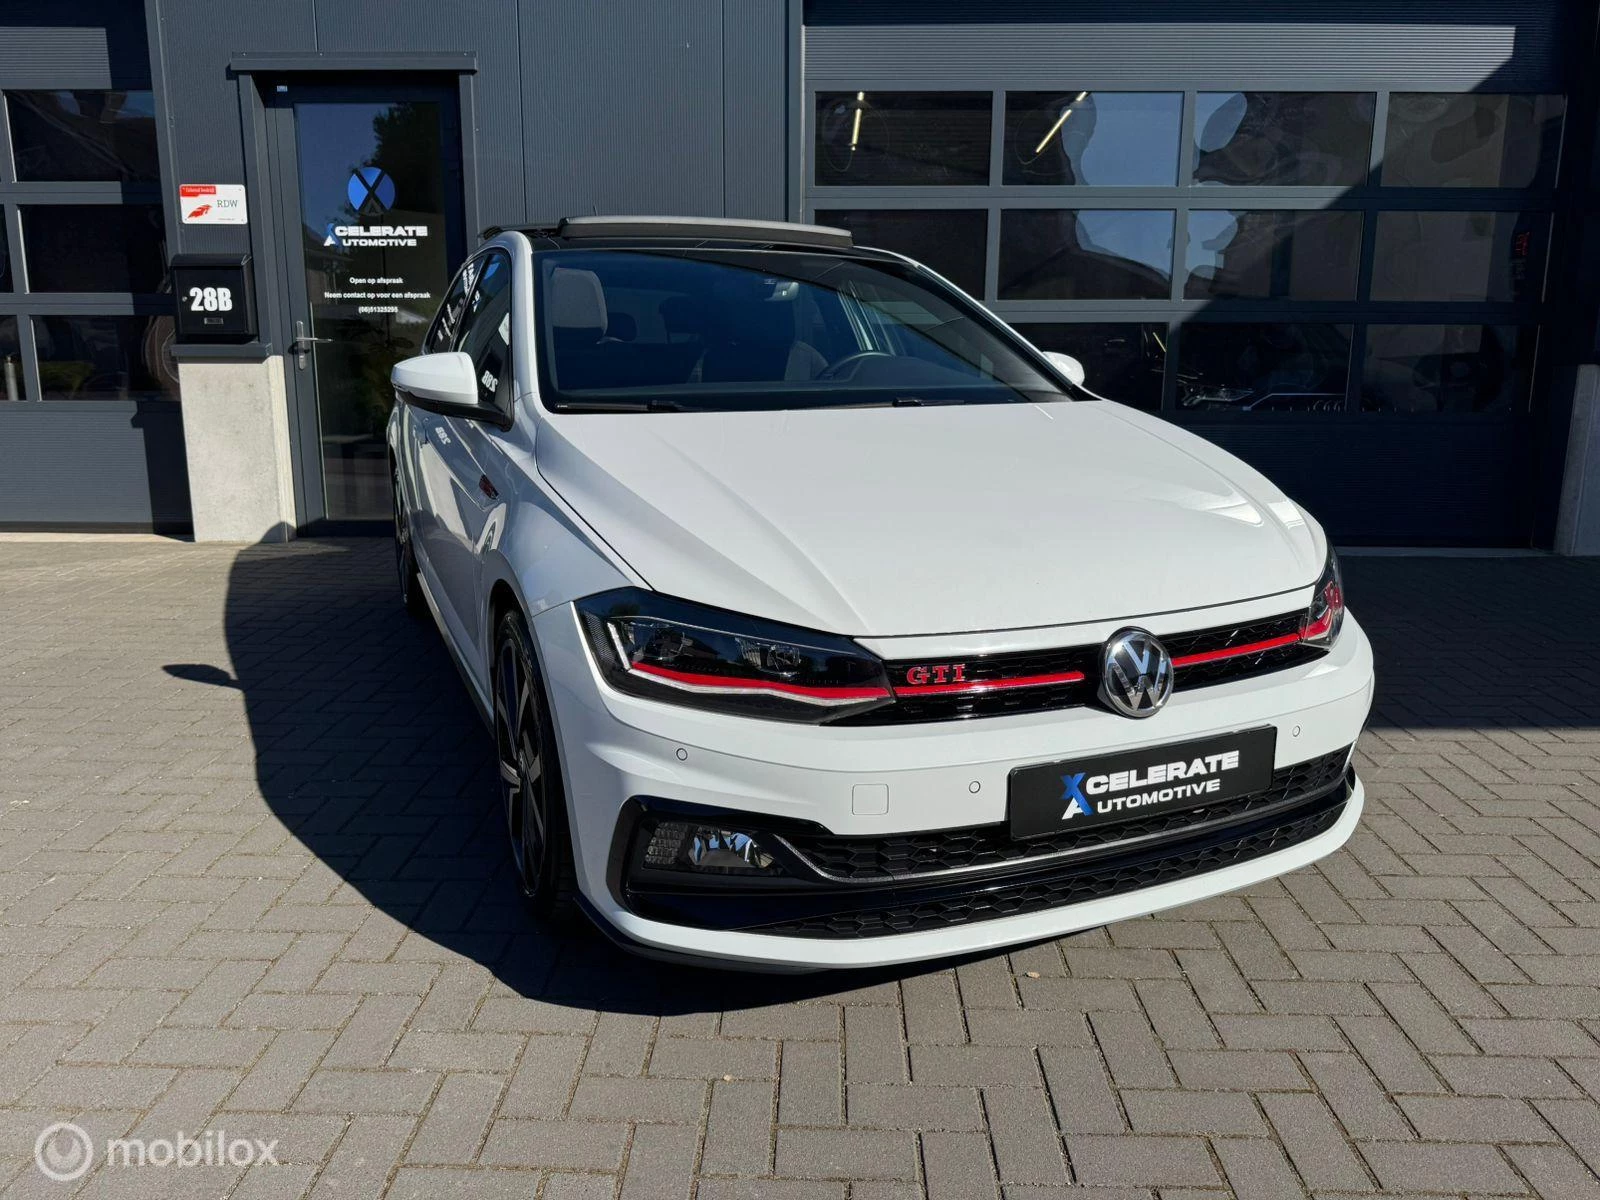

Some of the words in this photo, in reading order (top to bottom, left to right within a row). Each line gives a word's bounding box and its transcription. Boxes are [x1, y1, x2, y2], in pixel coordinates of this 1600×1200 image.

[217, 200, 238, 208] RDW
[324, 235, 417, 246] AUTOMOTIVE
[349, 277, 366, 285] Open
[377, 277, 404, 285] afspraak
[190, 287, 232, 311] 28B
[907, 663, 966, 685] GTI
[1061, 778, 1221, 819] AUTOMOTIVE
